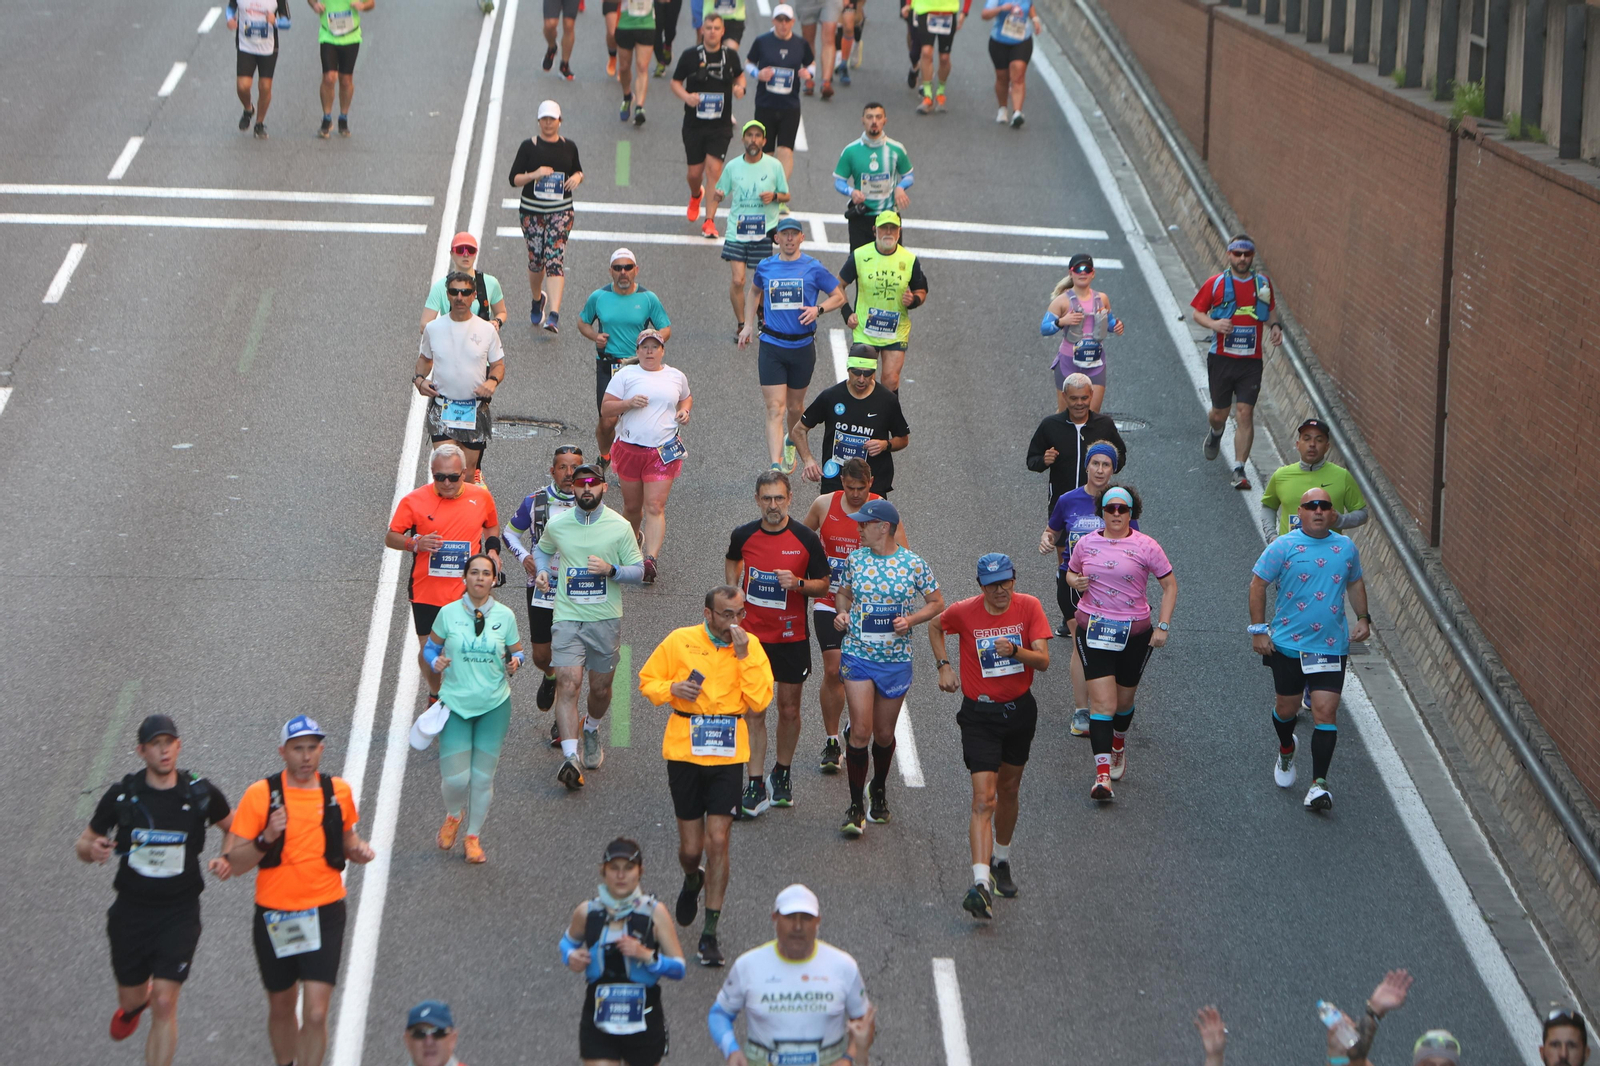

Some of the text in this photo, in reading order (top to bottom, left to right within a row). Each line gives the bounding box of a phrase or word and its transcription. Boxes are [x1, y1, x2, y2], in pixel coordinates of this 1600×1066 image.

[835, 422, 874, 436] GO DANI
[973, 622, 1024, 638] CANADA
[761, 990, 834, 1003] ALMAGRO
